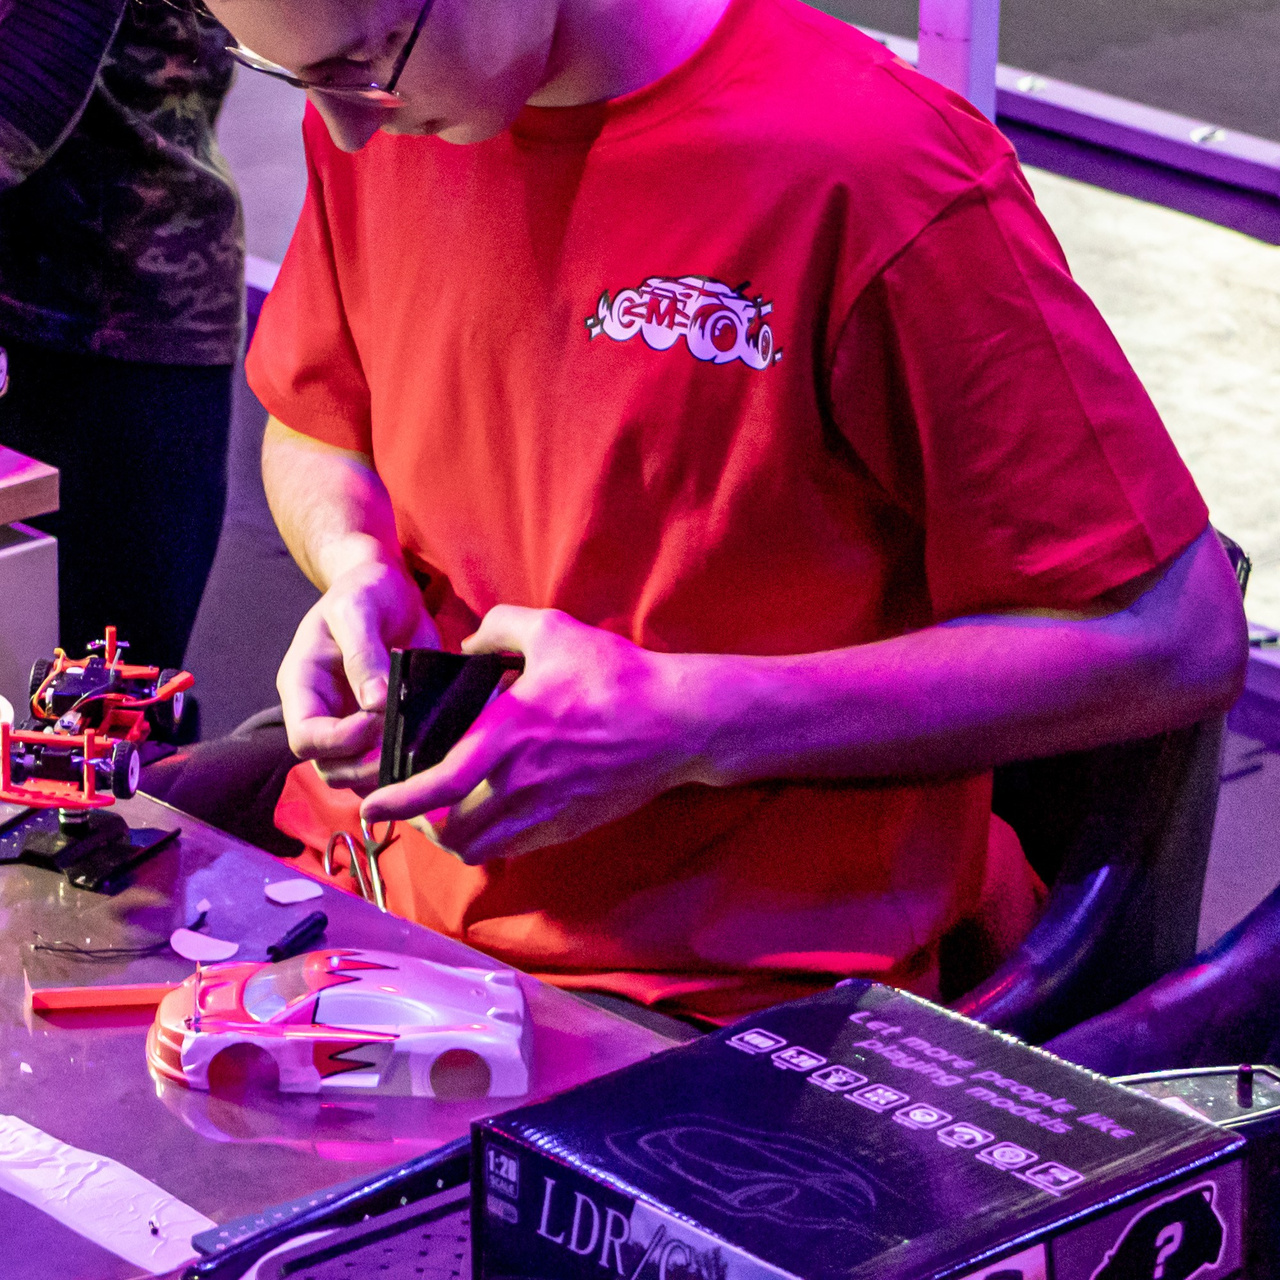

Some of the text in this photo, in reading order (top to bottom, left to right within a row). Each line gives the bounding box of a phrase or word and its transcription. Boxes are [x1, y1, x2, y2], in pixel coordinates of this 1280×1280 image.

[849, 1012, 1135, 1138] Let more people like
[853, 1039, 1073, 1133] playing models
